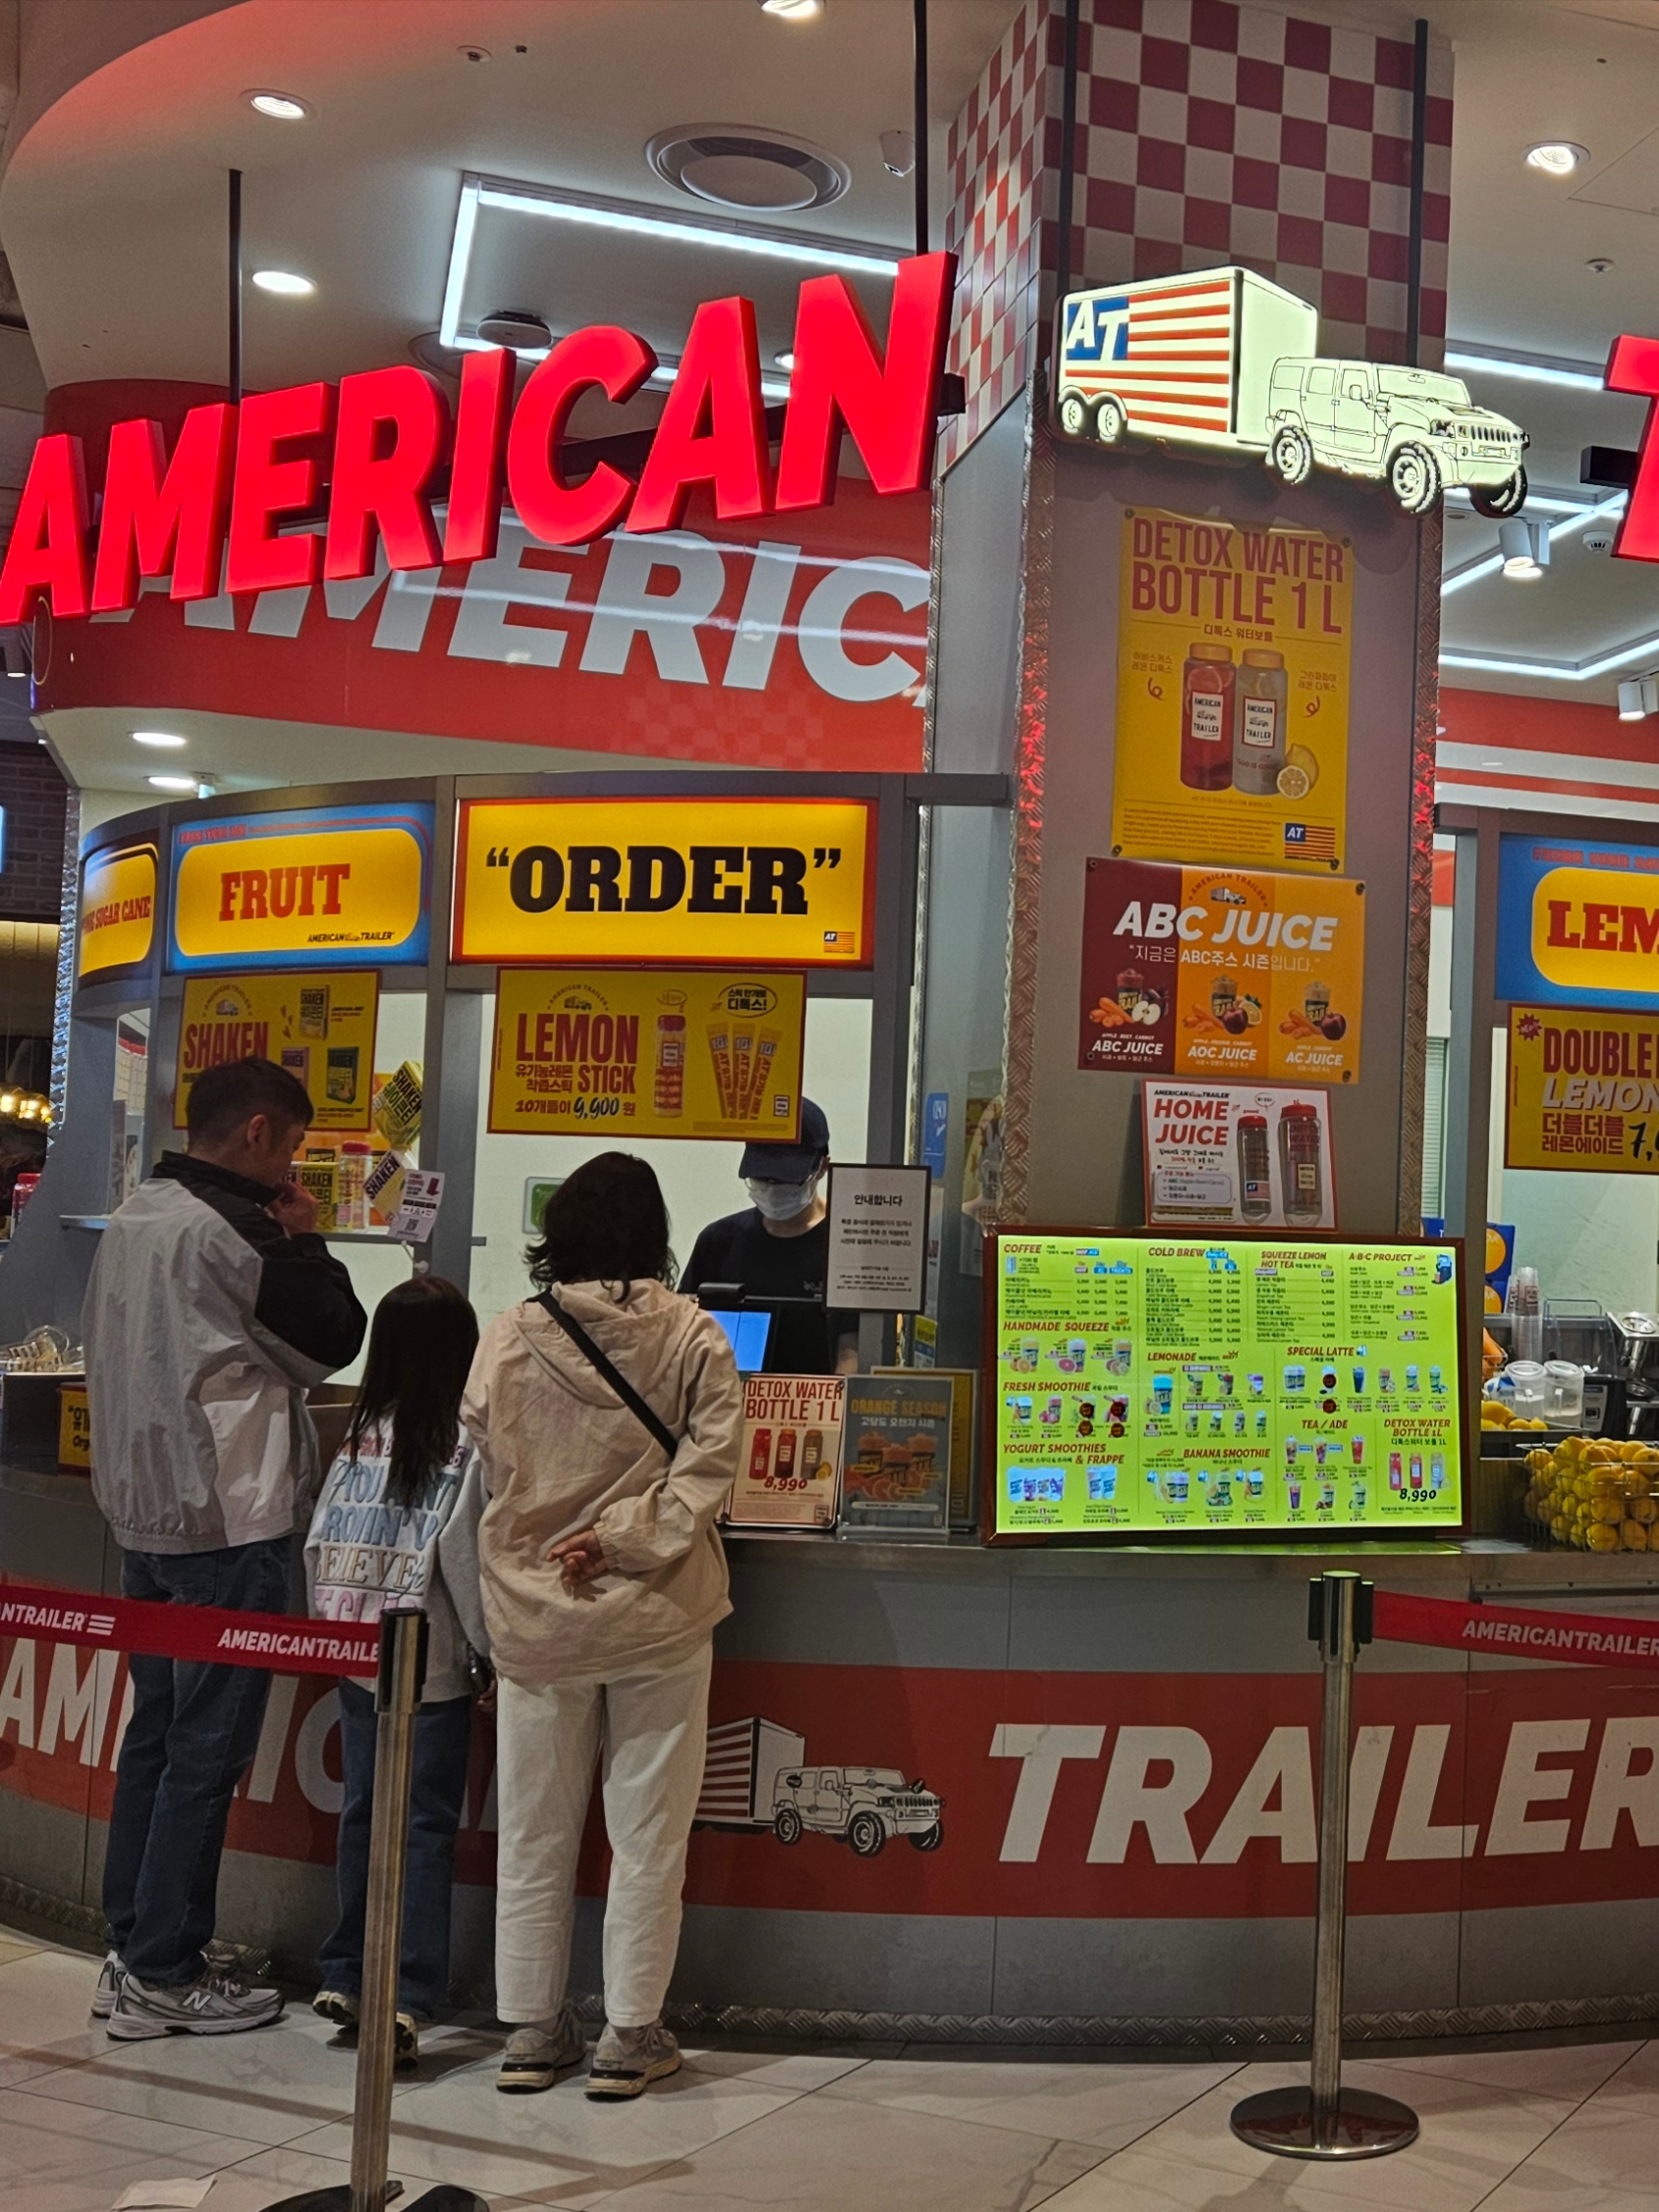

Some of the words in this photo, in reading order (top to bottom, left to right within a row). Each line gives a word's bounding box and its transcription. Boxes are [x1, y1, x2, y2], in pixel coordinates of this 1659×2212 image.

[1068, 300, 1128, 360] AT
[0, 250, 958, 627] AMERICAN
[1134, 518, 1233, 569] DETOX
[1243, 531, 1344, 583] WATER
[1132, 561, 1276, 626] BOTTLE
[1292, 581, 1307, 630] 1
[1323, 584, 1343, 634] L
[88, 526, 926, 705] ERIC
[1204, 624, 1232, 637] 디톡스
[1194, 696, 1221, 708] AMERICAN
[1246, 703, 1273, 715] AMERICAN
[1193, 722, 1219, 734] TRAILER
[1245, 728, 1271, 740] TRAILER
[1287, 826, 1304, 839] AT
[485, 845, 842, 914] “ORDER”
[1191, 872, 1233, 895] AMERICAN
[1236, 874, 1266, 901] TRAILER
[219, 863, 351, 921] FRUIT
[122, 896, 150, 921] CANE
[1113, 901, 1208, 941] ABC
[1211, 909, 1339, 951] JUICE
[1547, 900, 1659, 954] LEM
[306, 933, 345, 944] AMERICAN
[360, 931, 393, 941] TRAILER
[1181, 950, 1239, 968] ABC주스
[550, 984, 581, 1005] AMERICAN
[727, 998, 767, 1011] 디톡스!
[184, 1022, 268, 1069] SHAKEN
[516, 1013, 639, 1064] LEMON
[1092, 1039, 1122, 1053] ABC
[1123, 1041, 1163, 1056] JUICE
[1188, 1046, 1217, 1059] AOC
[1218, 1047, 1257, 1061] JUICE
[1286, 1051, 1303, 1064] AC
[1305, 1052, 1344, 1067] JUICE
[1543, 1027, 1652, 1078] DOUBLE
[516, 1064, 574, 1078] 유기농레몬
[578, 1064, 636, 1094] STICK
[393, 1069, 422, 1114] SHAKEN
[1542, 1077, 1659, 1114] LEMON
[574, 1096, 620, 1120] 9,900
[623, 1101, 636, 1117] 원
[1154, 1098, 1230, 1121] HOME
[1542, 1113, 1625, 1137] 더블더블
[1155, 1124, 1230, 1146] JUICE
[1628, 1122, 1659, 1162] 7,
[1542, 1134, 1624, 1155] 레몬에이드
[302, 1172, 334, 1188] SHAKEN
[364, 1155, 401, 1200] SHAKEN
[854, 1194, 903, 1206] 안내합니다
[1004, 1244, 1042, 1253] COFFEE
[1148, 1247, 1175, 1256] COLD
[1177, 1247, 1205, 1257] BREW
[1261, 1250, 1298, 1259] SQUEEZE
[1003, 1321, 1061, 1331] HANDMADE
[1065, 1322, 1109, 1332] SQUEEZE
[1147, 1353, 1197, 1361] LEMONADE
[1287, 1347, 1324, 1355] SPECIAL
[1326, 1347, 1355, 1356] LATTE
[747, 1380, 792, 1398] DETOX
[796, 1381, 844, 1400] WATER
[1003, 1382, 1035, 1391] FRESH
[1037, 1382, 1091, 1392] SMOOTHIE
[745, 1399, 810, 1420] BOTTLE
[817, 1401, 825, 1421] 1
[830, 1402, 840, 1421] L
[851, 1399, 898, 1415] ORANGE
[1302, 1419, 1318, 1428] TEA
[1329, 1419, 1348, 1428] ADE
[1393, 1427, 1429, 1437] BOTTLE
[1432, 1428, 1443, 1437] 1L
[1417, 1419, 1451, 1428] WATER
[73, 1435, 90, 1452] Org
[1003, 1444, 1045, 1454] YOGURT
[1047, 1443, 1106, 1454] SMOOTHIES
[1075, 1455, 1083, 1465] &
[1087, 1455, 1125, 1465] FRAPPE
[1184, 1449, 1221, 1459] BANANA
[1222, 1448, 1270, 1459] SMOOTHIE
[764, 1475, 807, 1492] 8,990
[1399, 1488, 1437, 1503] 8,990
[0, 1602, 85, 1631] NTRAILER
[218, 1629, 379, 1664] AMERICANTRAILE
[1462, 1620, 1659, 1657] AMERICANTRAILER
[989, 1716, 1659, 1864] TRAILER
